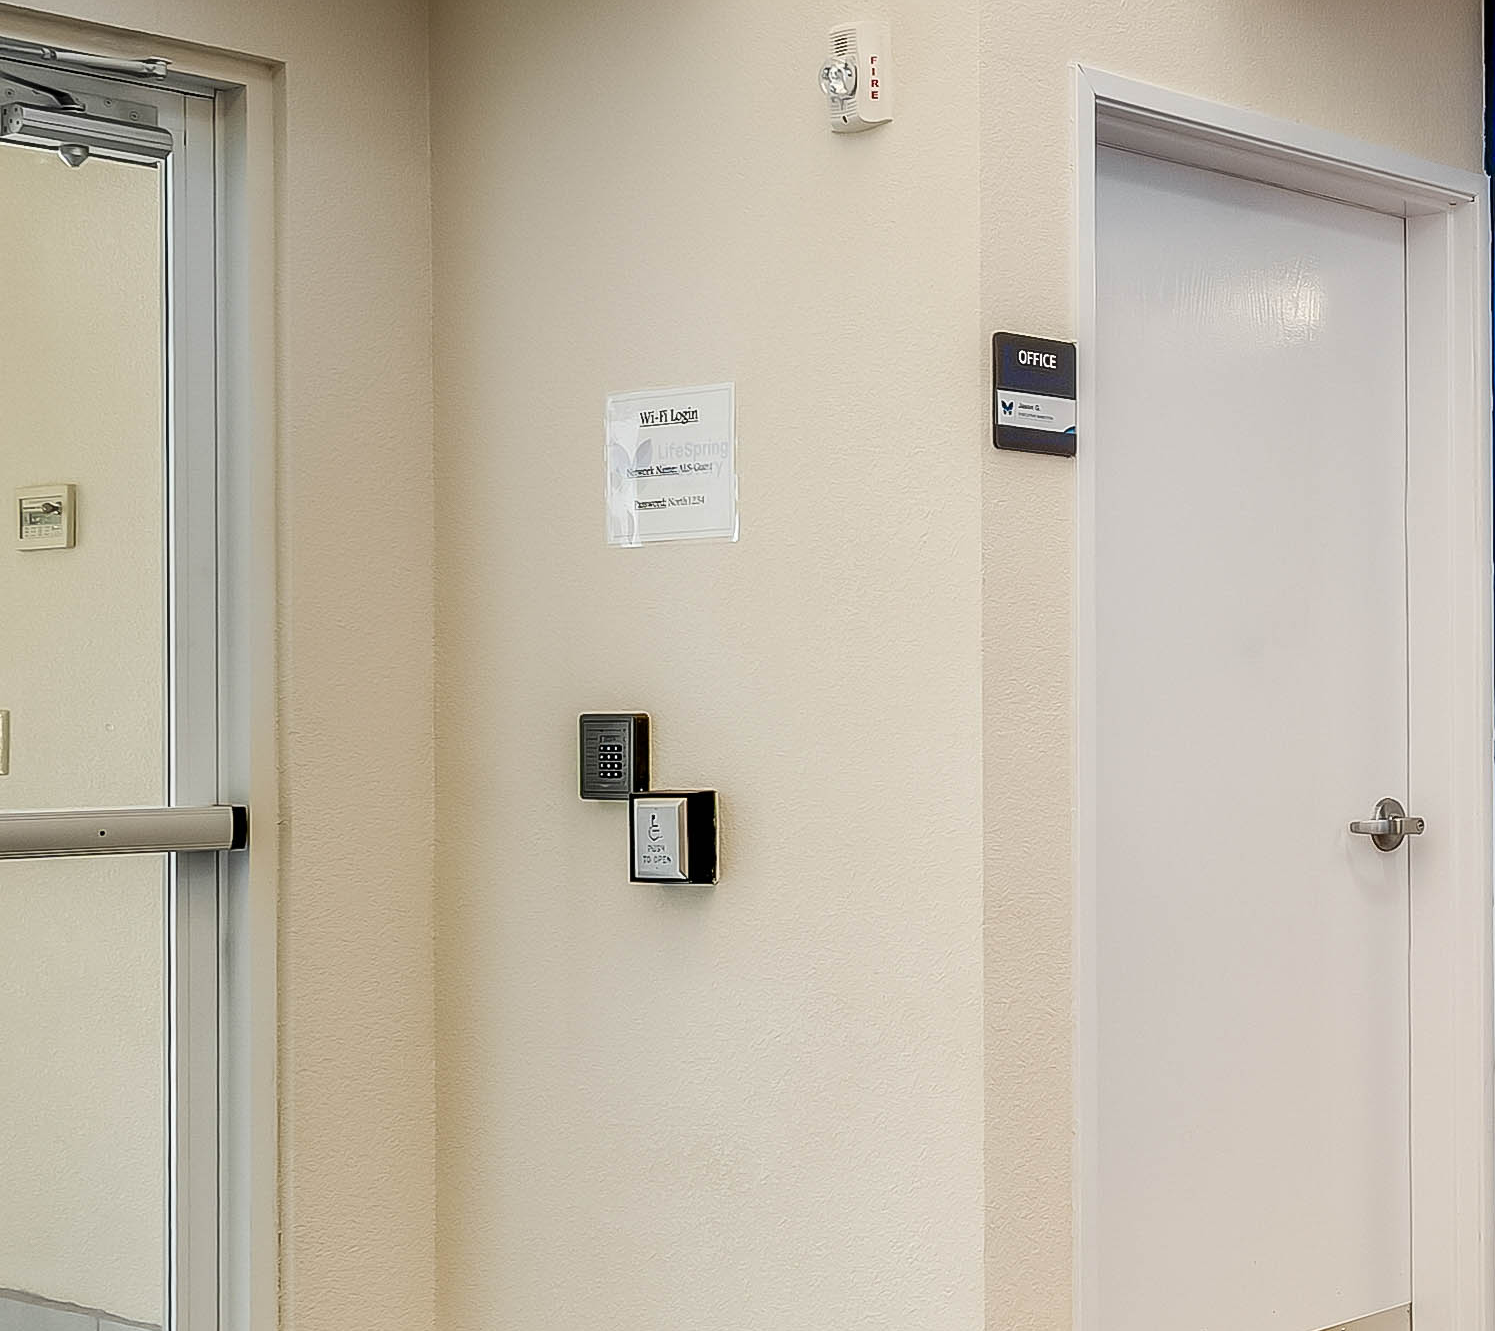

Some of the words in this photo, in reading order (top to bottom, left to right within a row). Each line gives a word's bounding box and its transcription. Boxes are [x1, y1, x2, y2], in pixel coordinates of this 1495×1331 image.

[871, 57, 880, 100] FIRE
[1018, 350, 1057, 369] OFFICE
[640, 409, 668, 426] Wi-Fi
[671, 406, 699, 425] Login
[657, 439, 729, 461] LifeSpring
